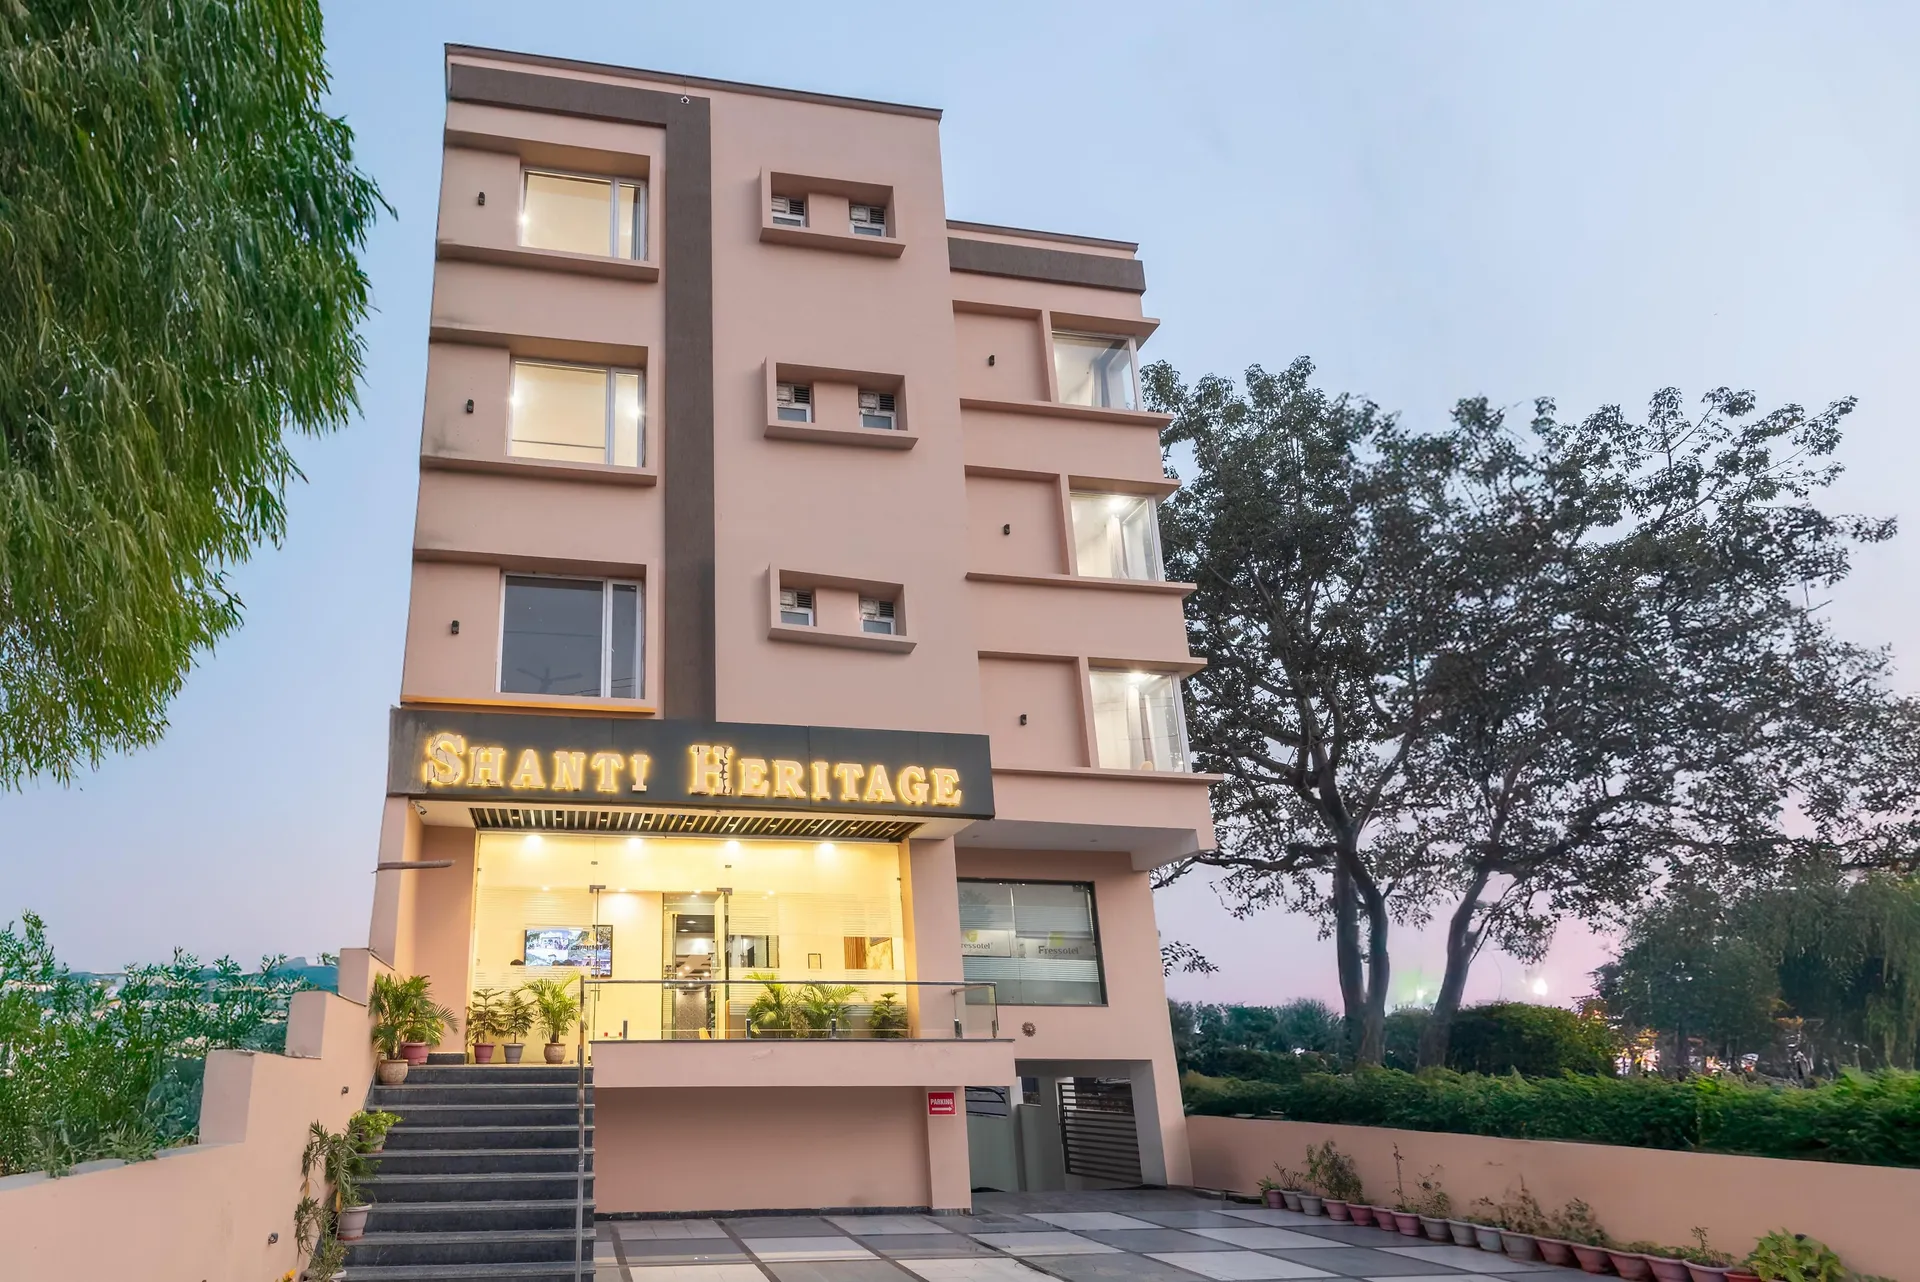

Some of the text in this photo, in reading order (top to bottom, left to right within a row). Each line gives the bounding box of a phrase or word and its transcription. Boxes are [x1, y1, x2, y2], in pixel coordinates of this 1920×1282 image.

[426, 734, 962, 806] SHANTI HERITAGE
[930, 1098, 954, 1106] PARKING
